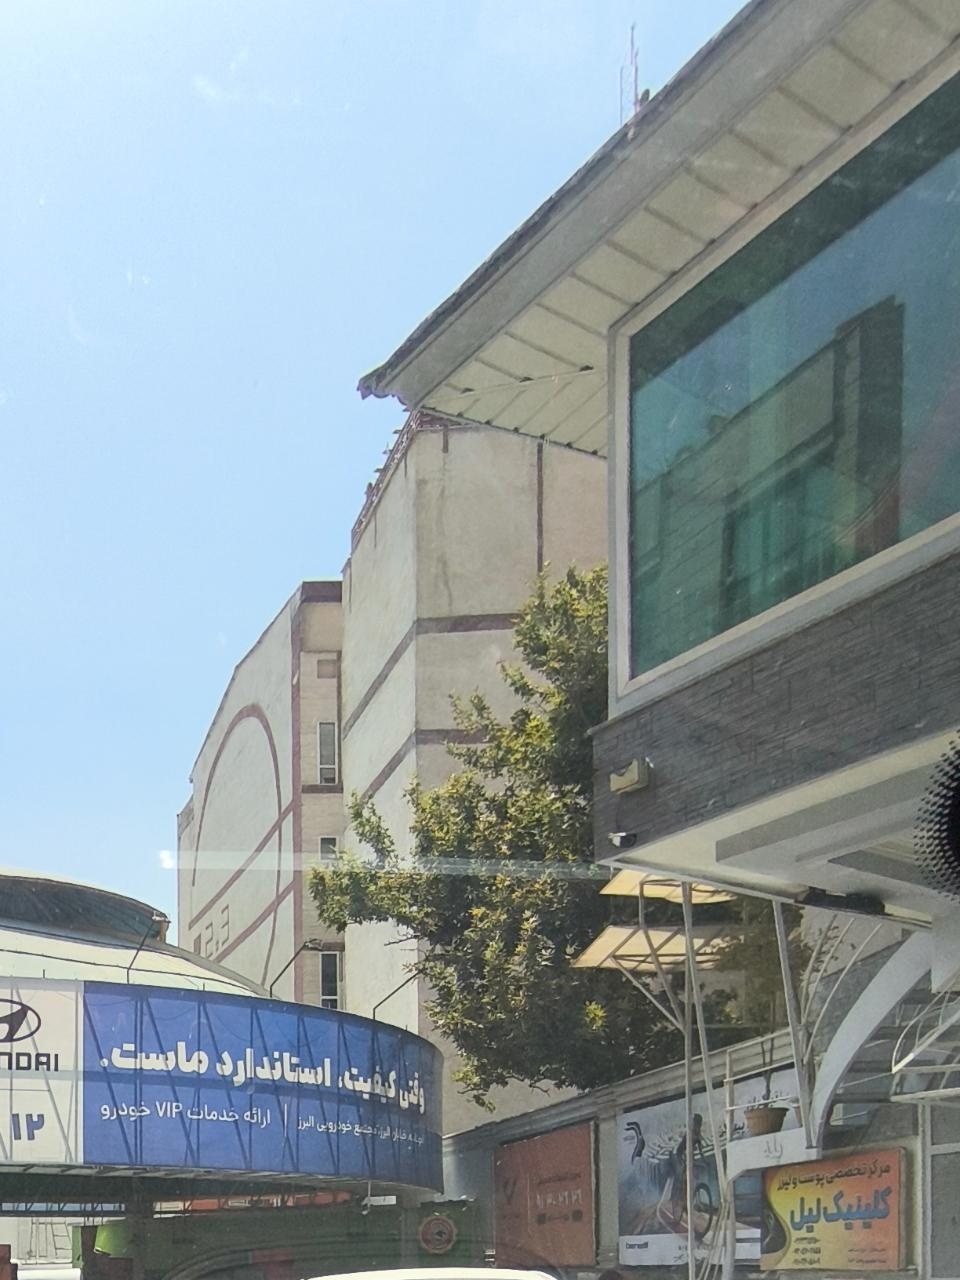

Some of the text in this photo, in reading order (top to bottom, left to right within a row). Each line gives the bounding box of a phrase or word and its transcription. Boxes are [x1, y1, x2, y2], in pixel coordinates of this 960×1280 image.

[100, 1040, 425, 1115] وقتی کیفیت، استاندارد ماست.
[101, 1101, 151, 1121] خودرو
[155, 1101, 183, 1118] VIP
[187, 1103, 239, 1122] خدمات
[244, 1109, 271, 1129] ارائه
[297, 1115, 314, 1130] البرز
[825, 1165, 866, 1185] تخصصی
[867, 1159, 891, 1178] مرکز
[822, 1186, 893, 1230] کلینیک
